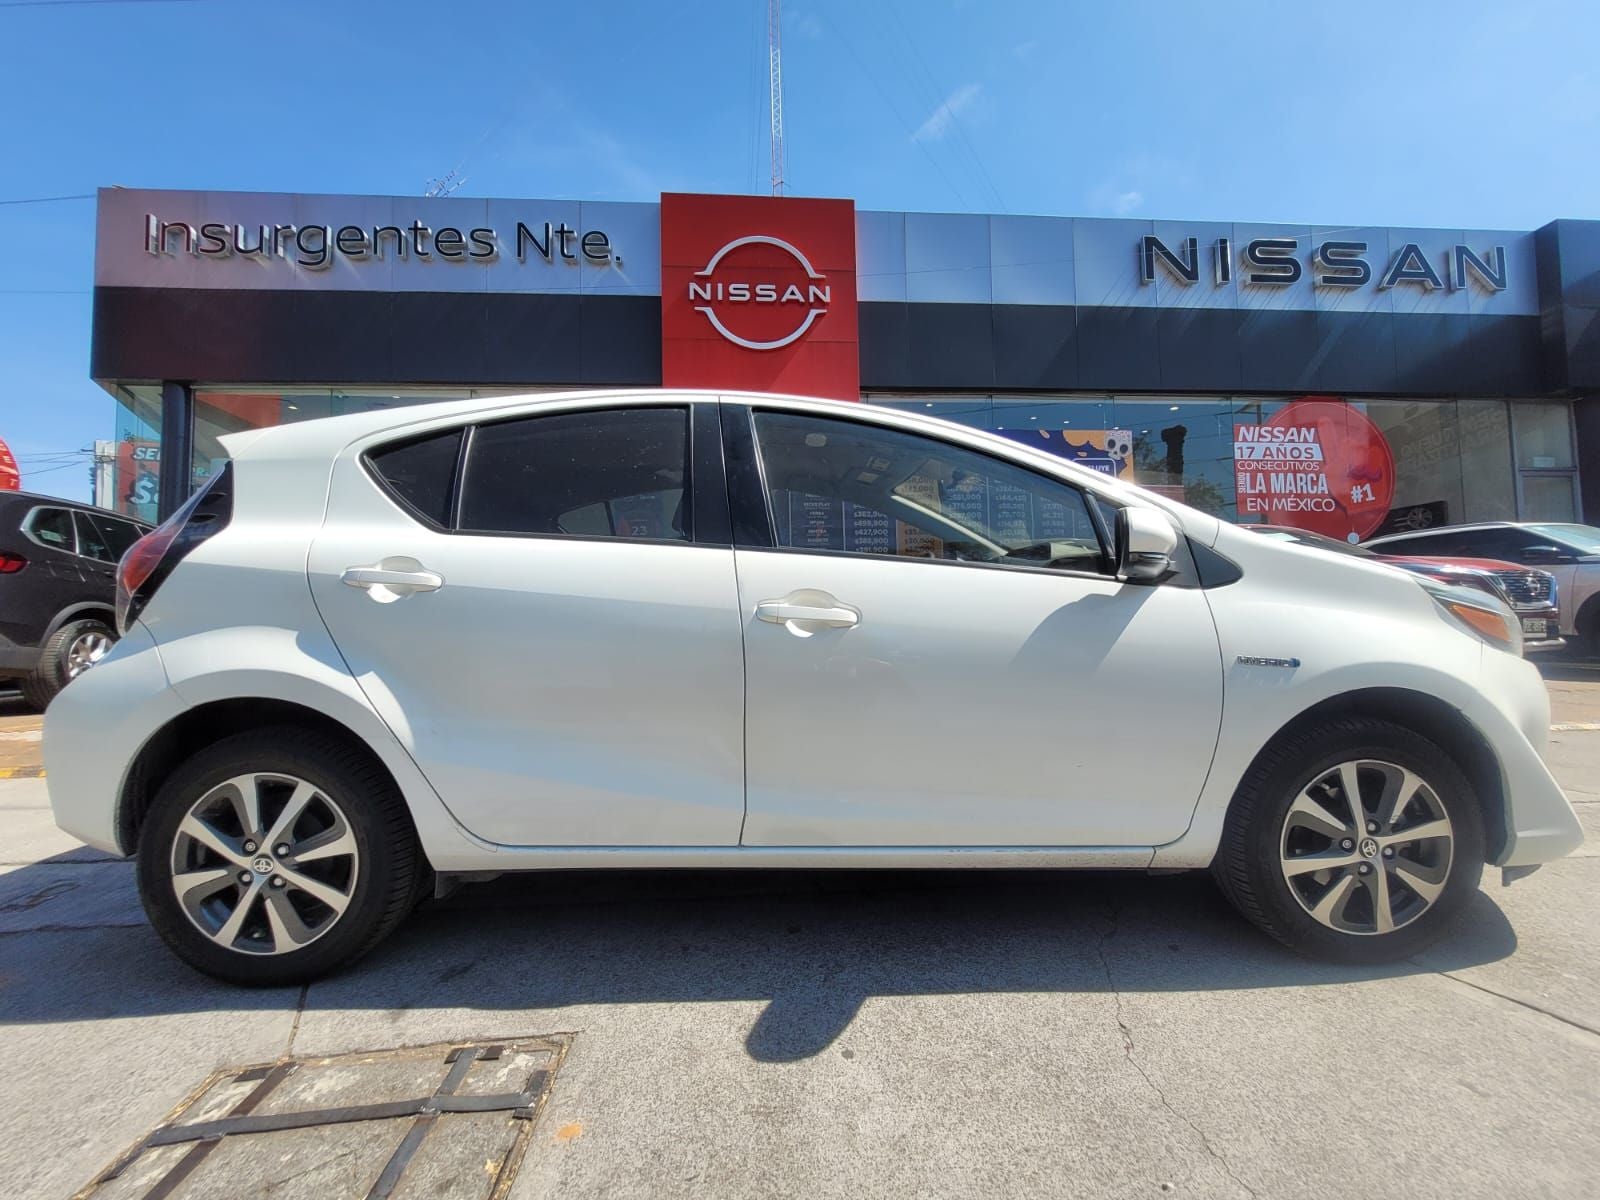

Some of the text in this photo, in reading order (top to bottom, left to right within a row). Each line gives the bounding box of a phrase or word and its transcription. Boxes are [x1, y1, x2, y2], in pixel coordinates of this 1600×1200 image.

[144, 213, 622, 270] Insurgentes Nte.
[1140, 234, 1508, 290] NISSAN
[688, 282, 831, 303] NISSAN
[1238, 426, 1315, 443] NISSAN
[1236, 444, 1315, 460] 17 AÑOS
[1237, 461, 1320, 471] CONSECUTIVOS
[1247, 473, 1329, 495] LA MARCA
[1350, 483, 1376, 503] #1
[1247, 495, 1335, 512] EN MÉXICO
